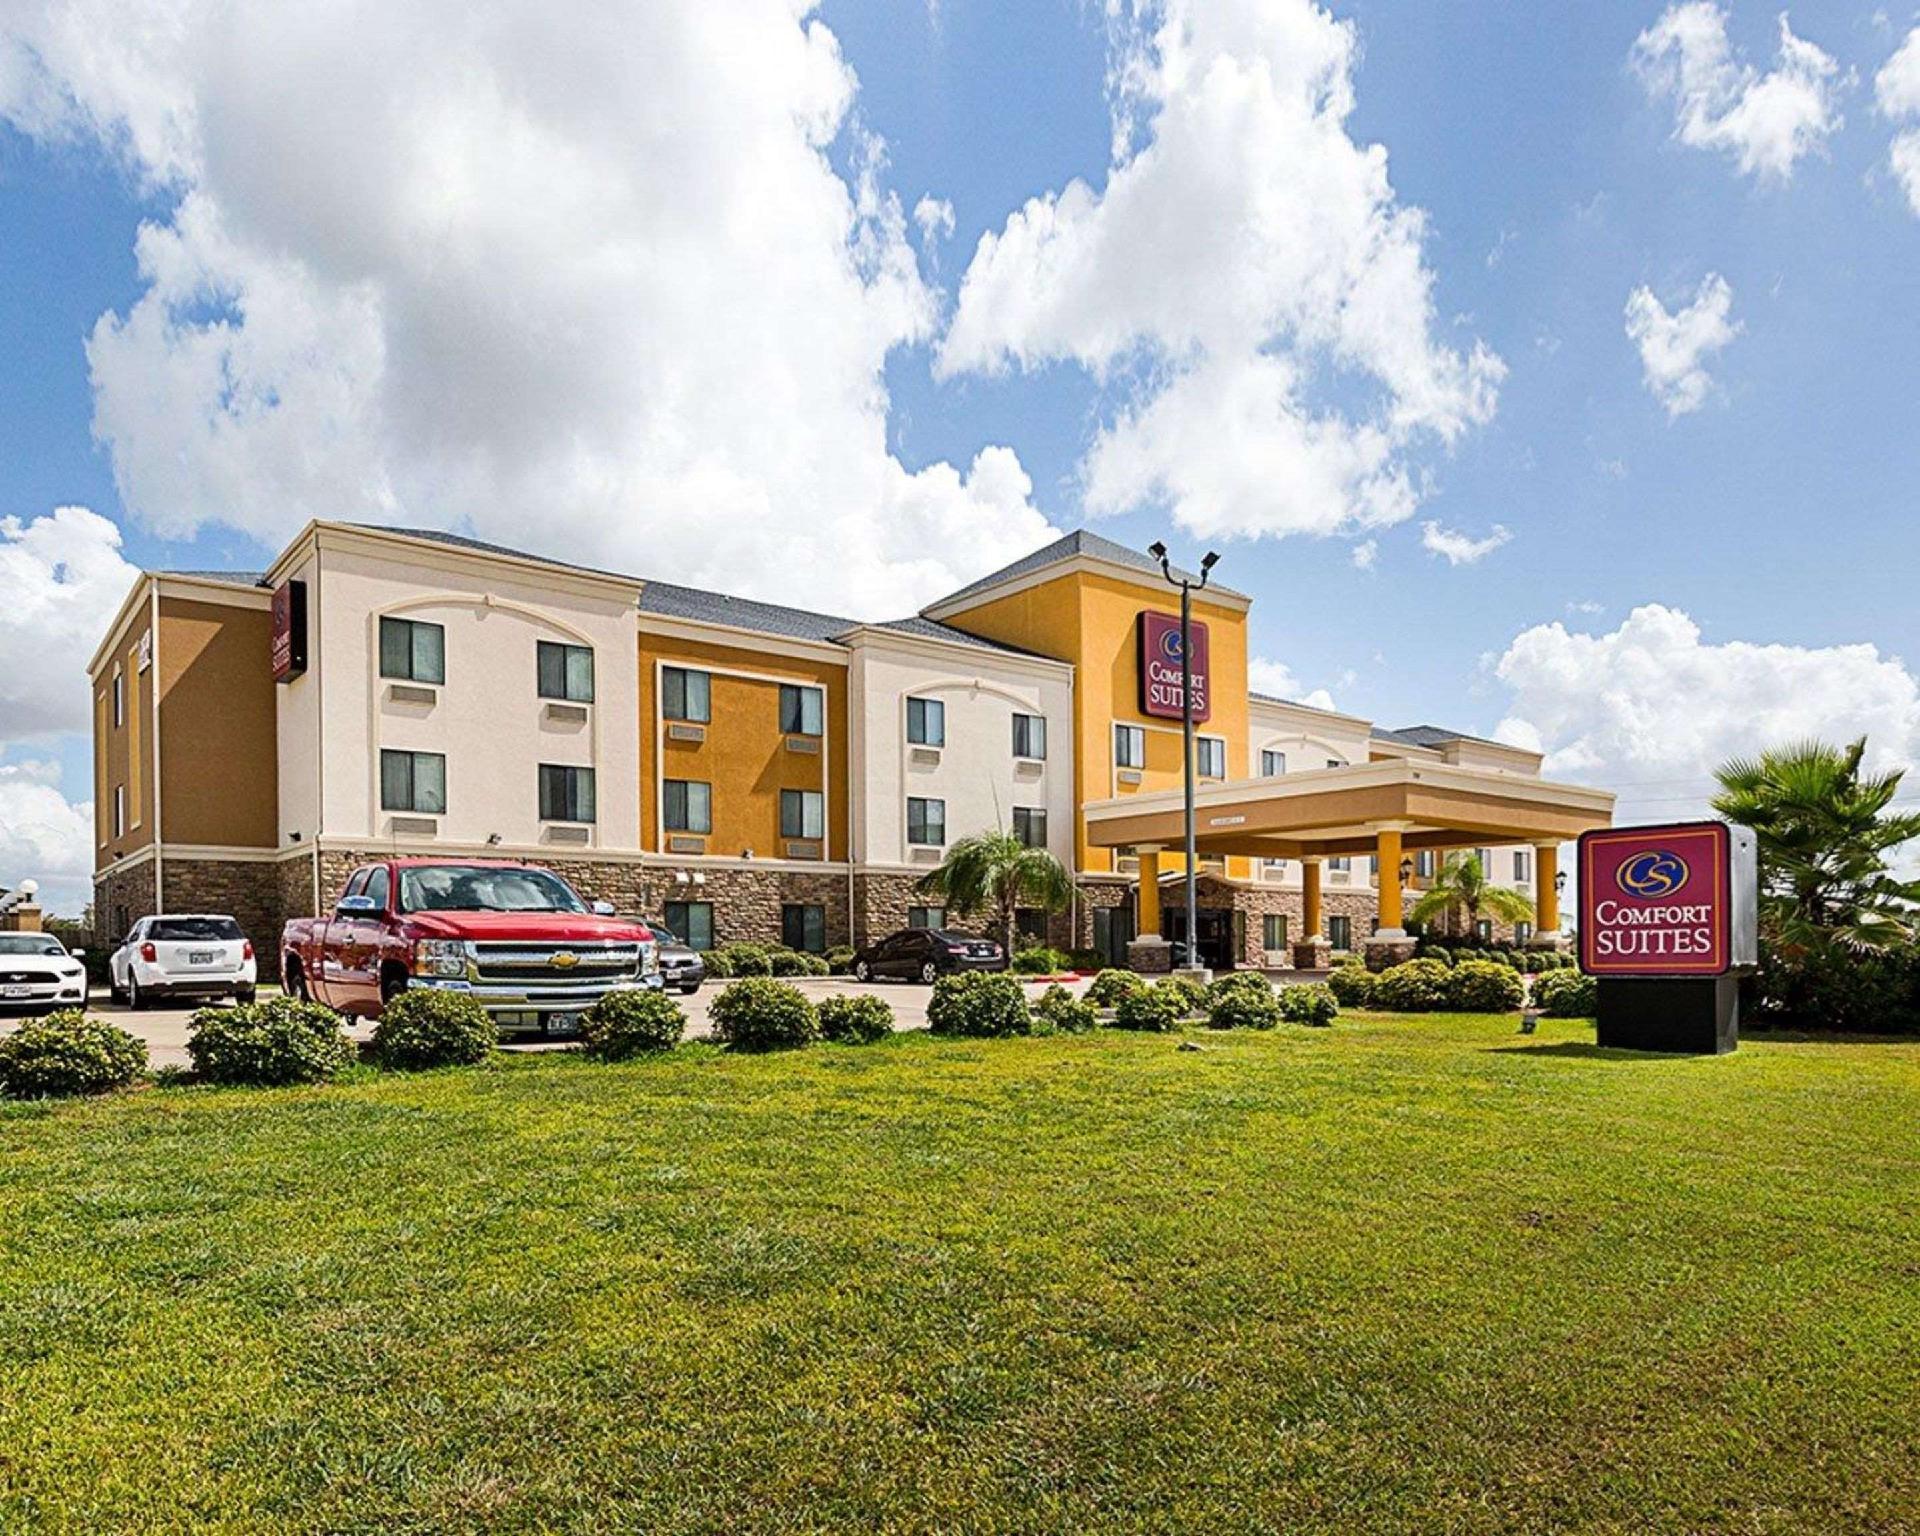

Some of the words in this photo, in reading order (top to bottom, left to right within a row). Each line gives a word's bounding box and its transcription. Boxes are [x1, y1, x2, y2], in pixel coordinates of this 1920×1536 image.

[1149, 660, 1205, 690] COMFRT
[1596, 900, 1712, 926] COMFORT
[1596, 928, 1712, 955] SUITES
